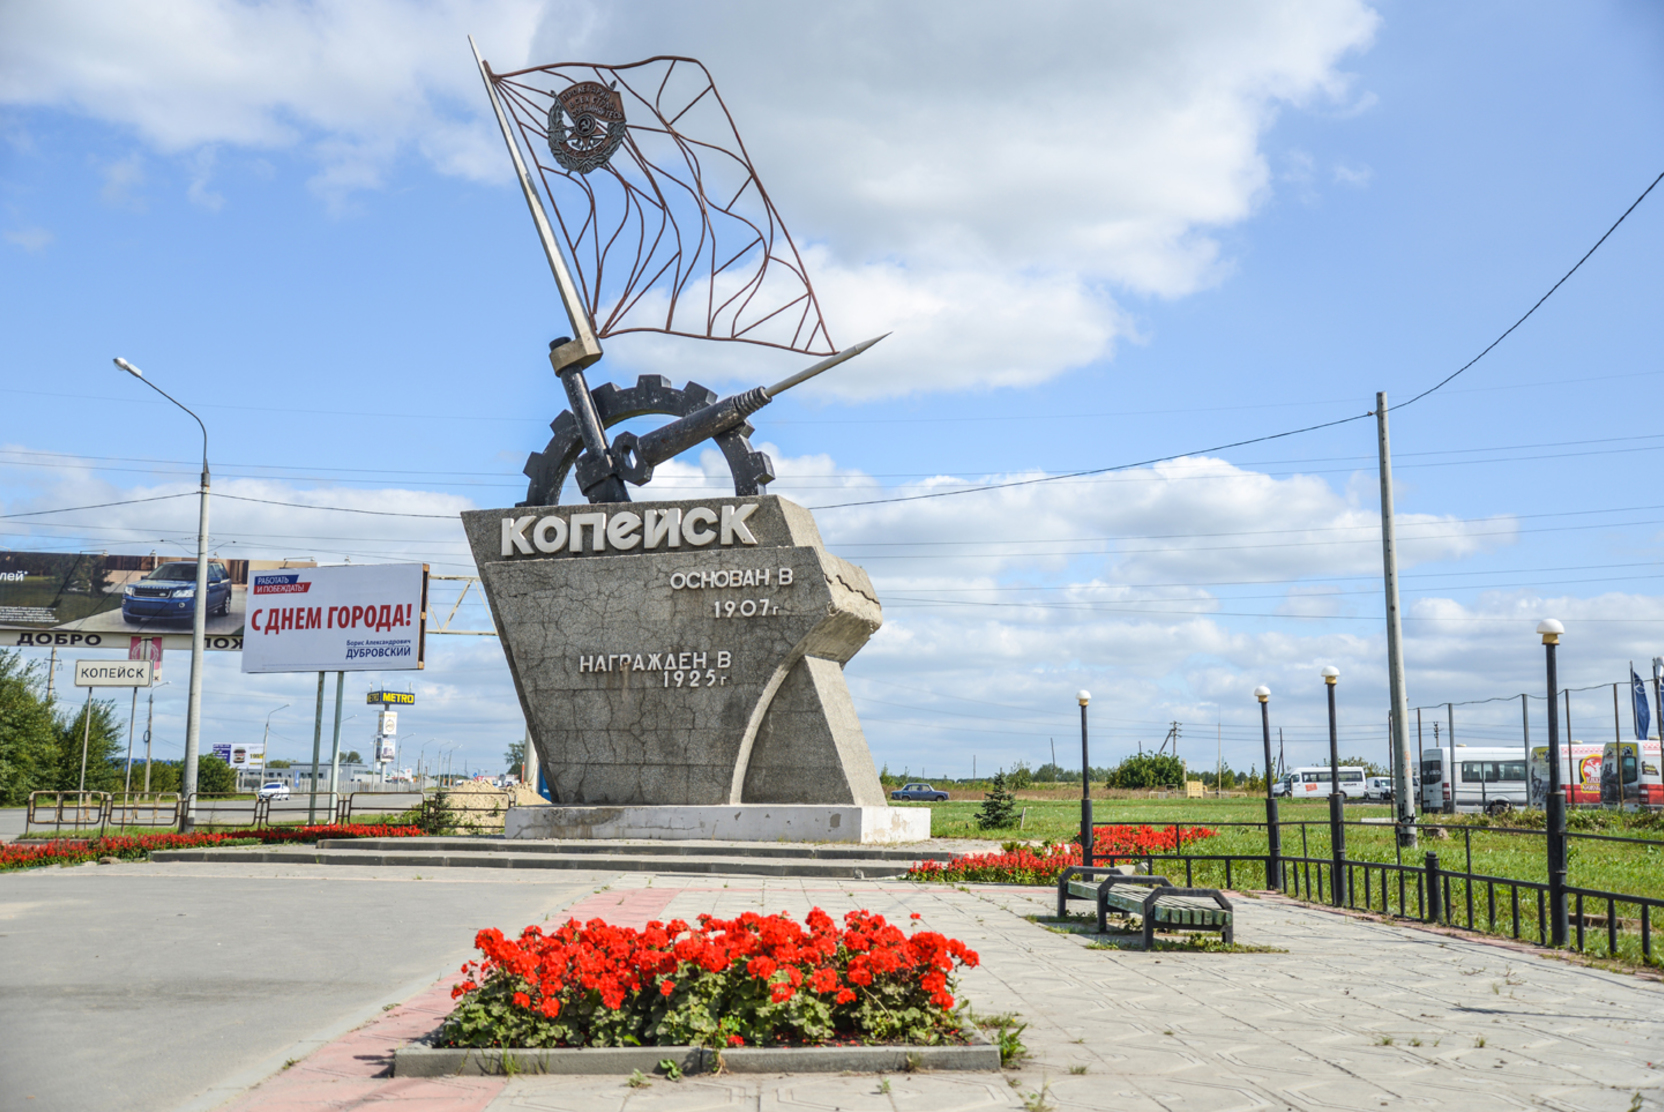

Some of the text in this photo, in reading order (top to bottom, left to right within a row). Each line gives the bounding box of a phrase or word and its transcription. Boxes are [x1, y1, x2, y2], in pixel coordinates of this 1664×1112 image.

[257, 576, 289, 585] РАБОТАТЬ
[670, 567, 793, 590] ОСНОВАН В
[256, 583, 305, 593] И ПОБЕЖДАТЬ!
[251, 603, 412, 635] С ДНЕМ ГОРОДА!
[17, 633, 102, 646] ДОБРО
[346, 639, 411, 647] Борис Александрович
[345, 645, 411, 660] ДУБРОВСКИЙ
[580, 650, 732, 673] НАГРАЖДЕН В
[81, 666, 145, 679] КОПЕЙСК
[382, 692, 415, 704] METRO
